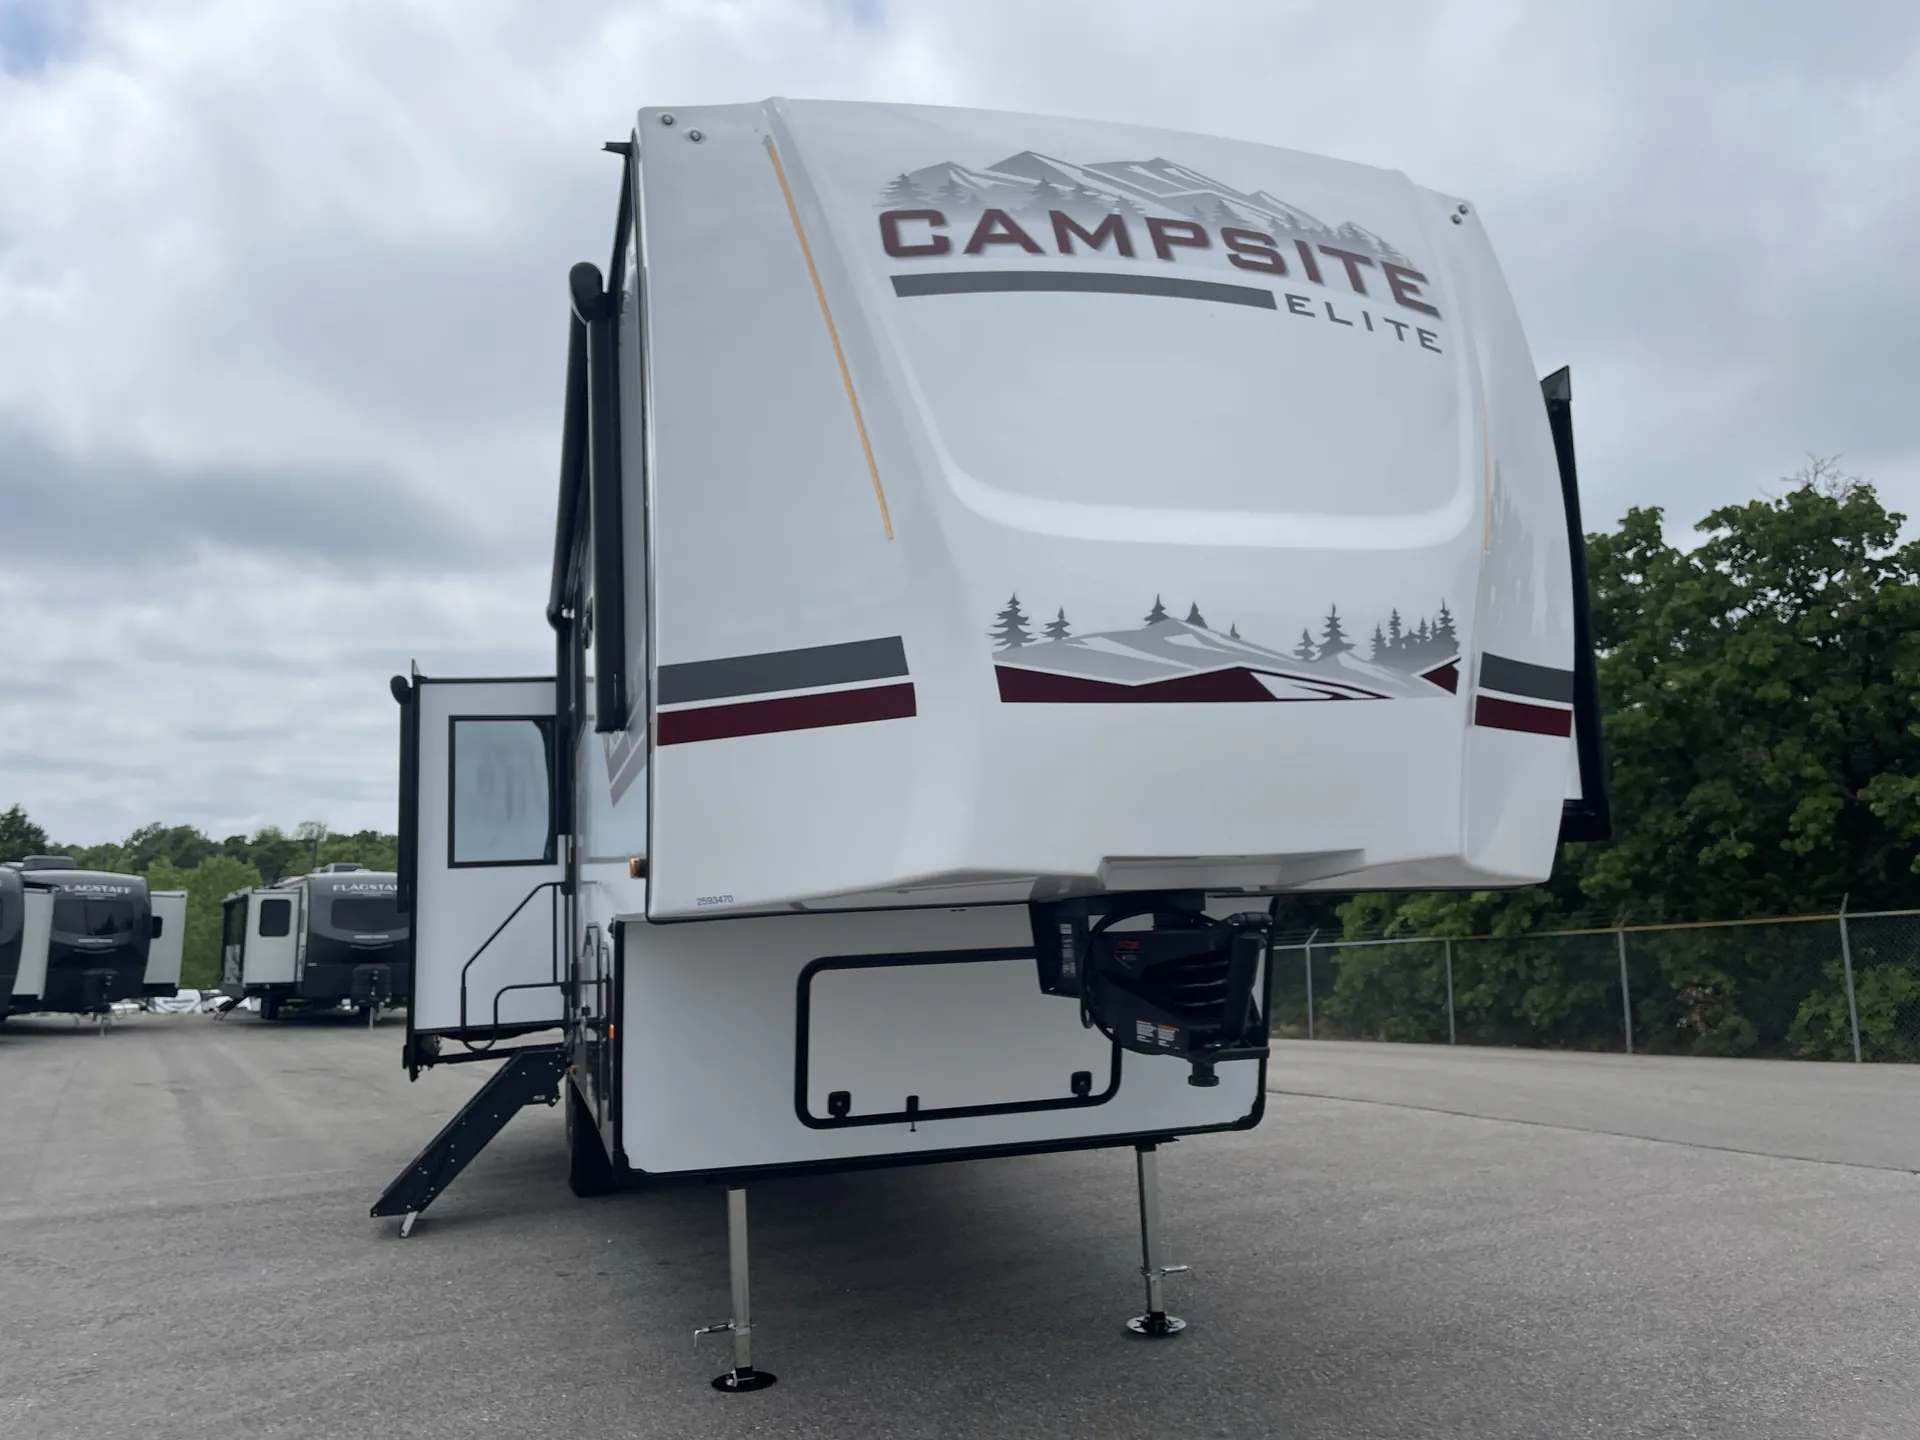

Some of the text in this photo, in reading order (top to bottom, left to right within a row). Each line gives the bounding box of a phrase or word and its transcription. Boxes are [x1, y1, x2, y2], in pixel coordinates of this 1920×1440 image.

[879, 208, 1441, 319] CAMPSITE
[1285, 293, 1442, 354] ELITE
[59, 884, 132, 894] LAGSTAFF
[332, 883, 398, 892] FLAGSTA
[696, 894, 734, 906] 2593470
